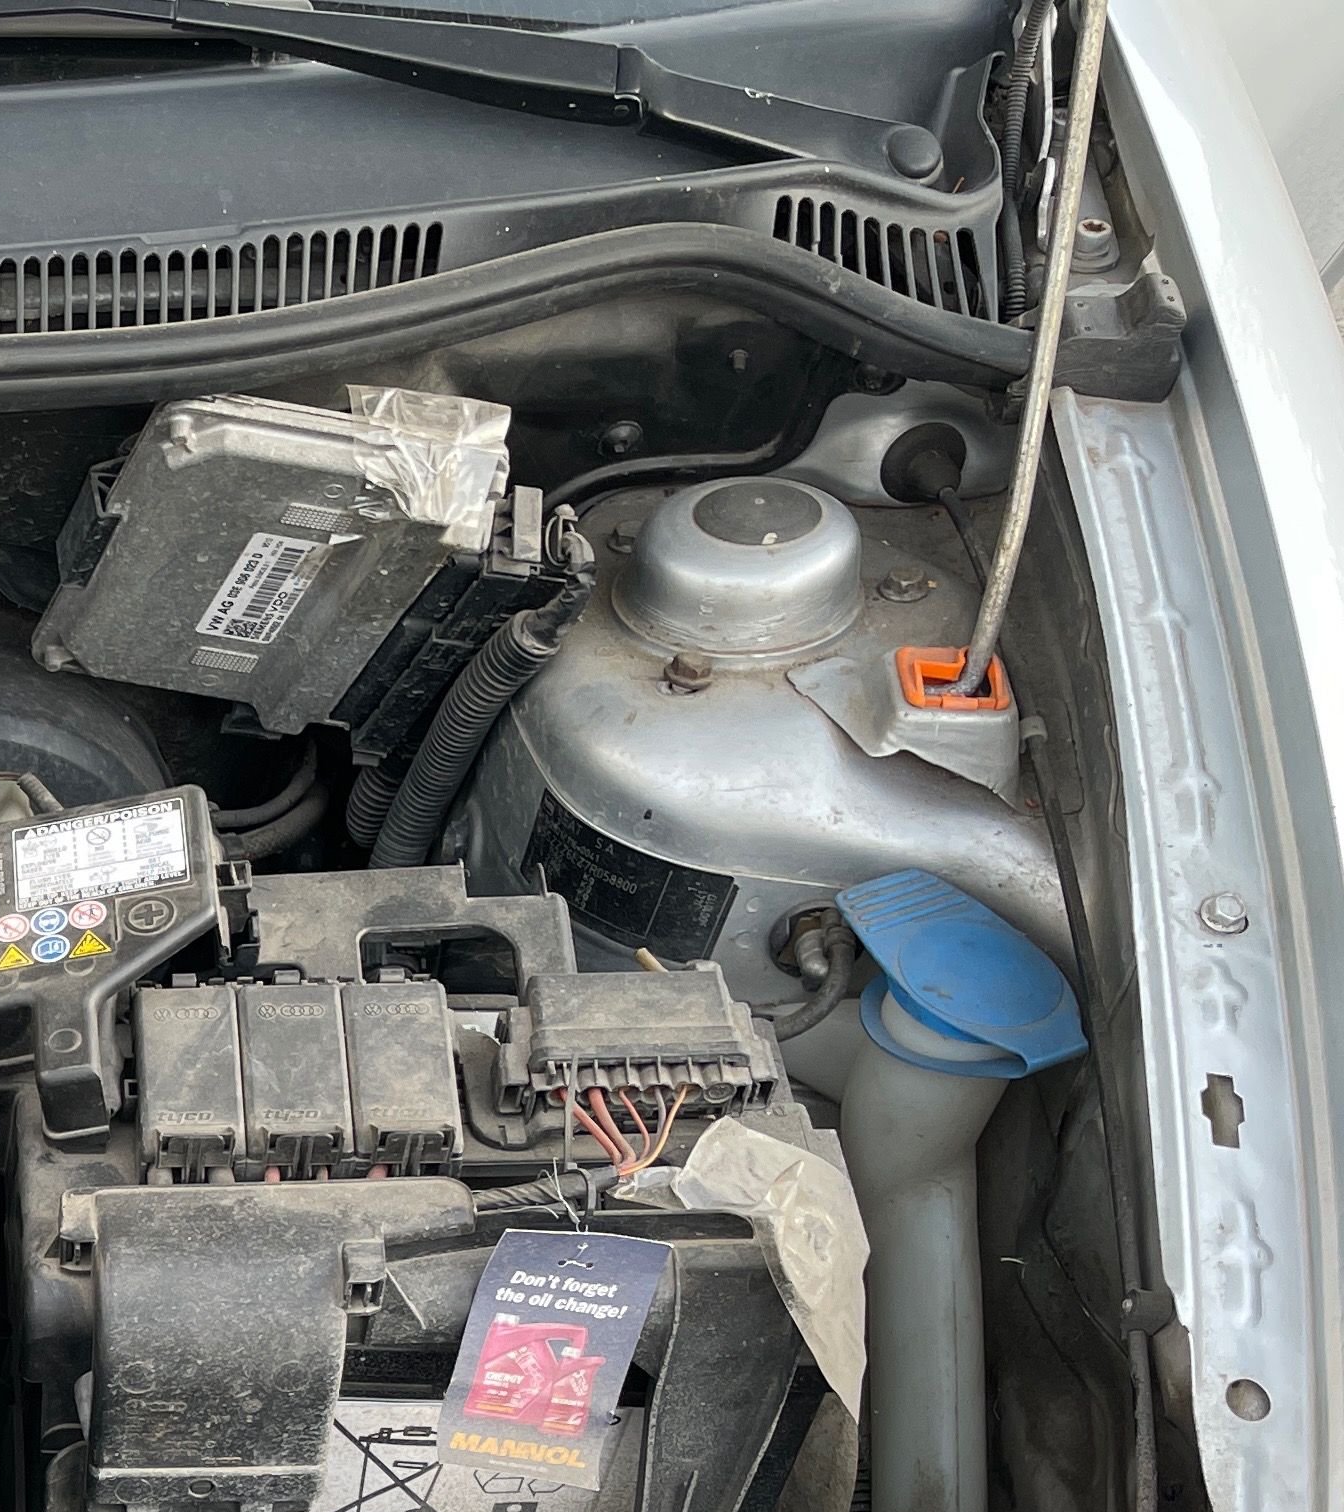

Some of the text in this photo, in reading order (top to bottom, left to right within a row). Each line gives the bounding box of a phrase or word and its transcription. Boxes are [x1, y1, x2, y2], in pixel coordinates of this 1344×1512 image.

[206, 615, 224, 631] VW
[217, 600, 234, 615] AG
[270, 591, 288, 613] VDO
[34, 803, 173, 835] DANGER/POISON
[158, 1109, 213, 1124] tyco
[264, 1108, 319, 1122] tyco
[510, 1270, 618, 1298] Don't forget
[495, 1287, 629, 1319] the oil change!
[450, 1431, 586, 1468] MANNOL
